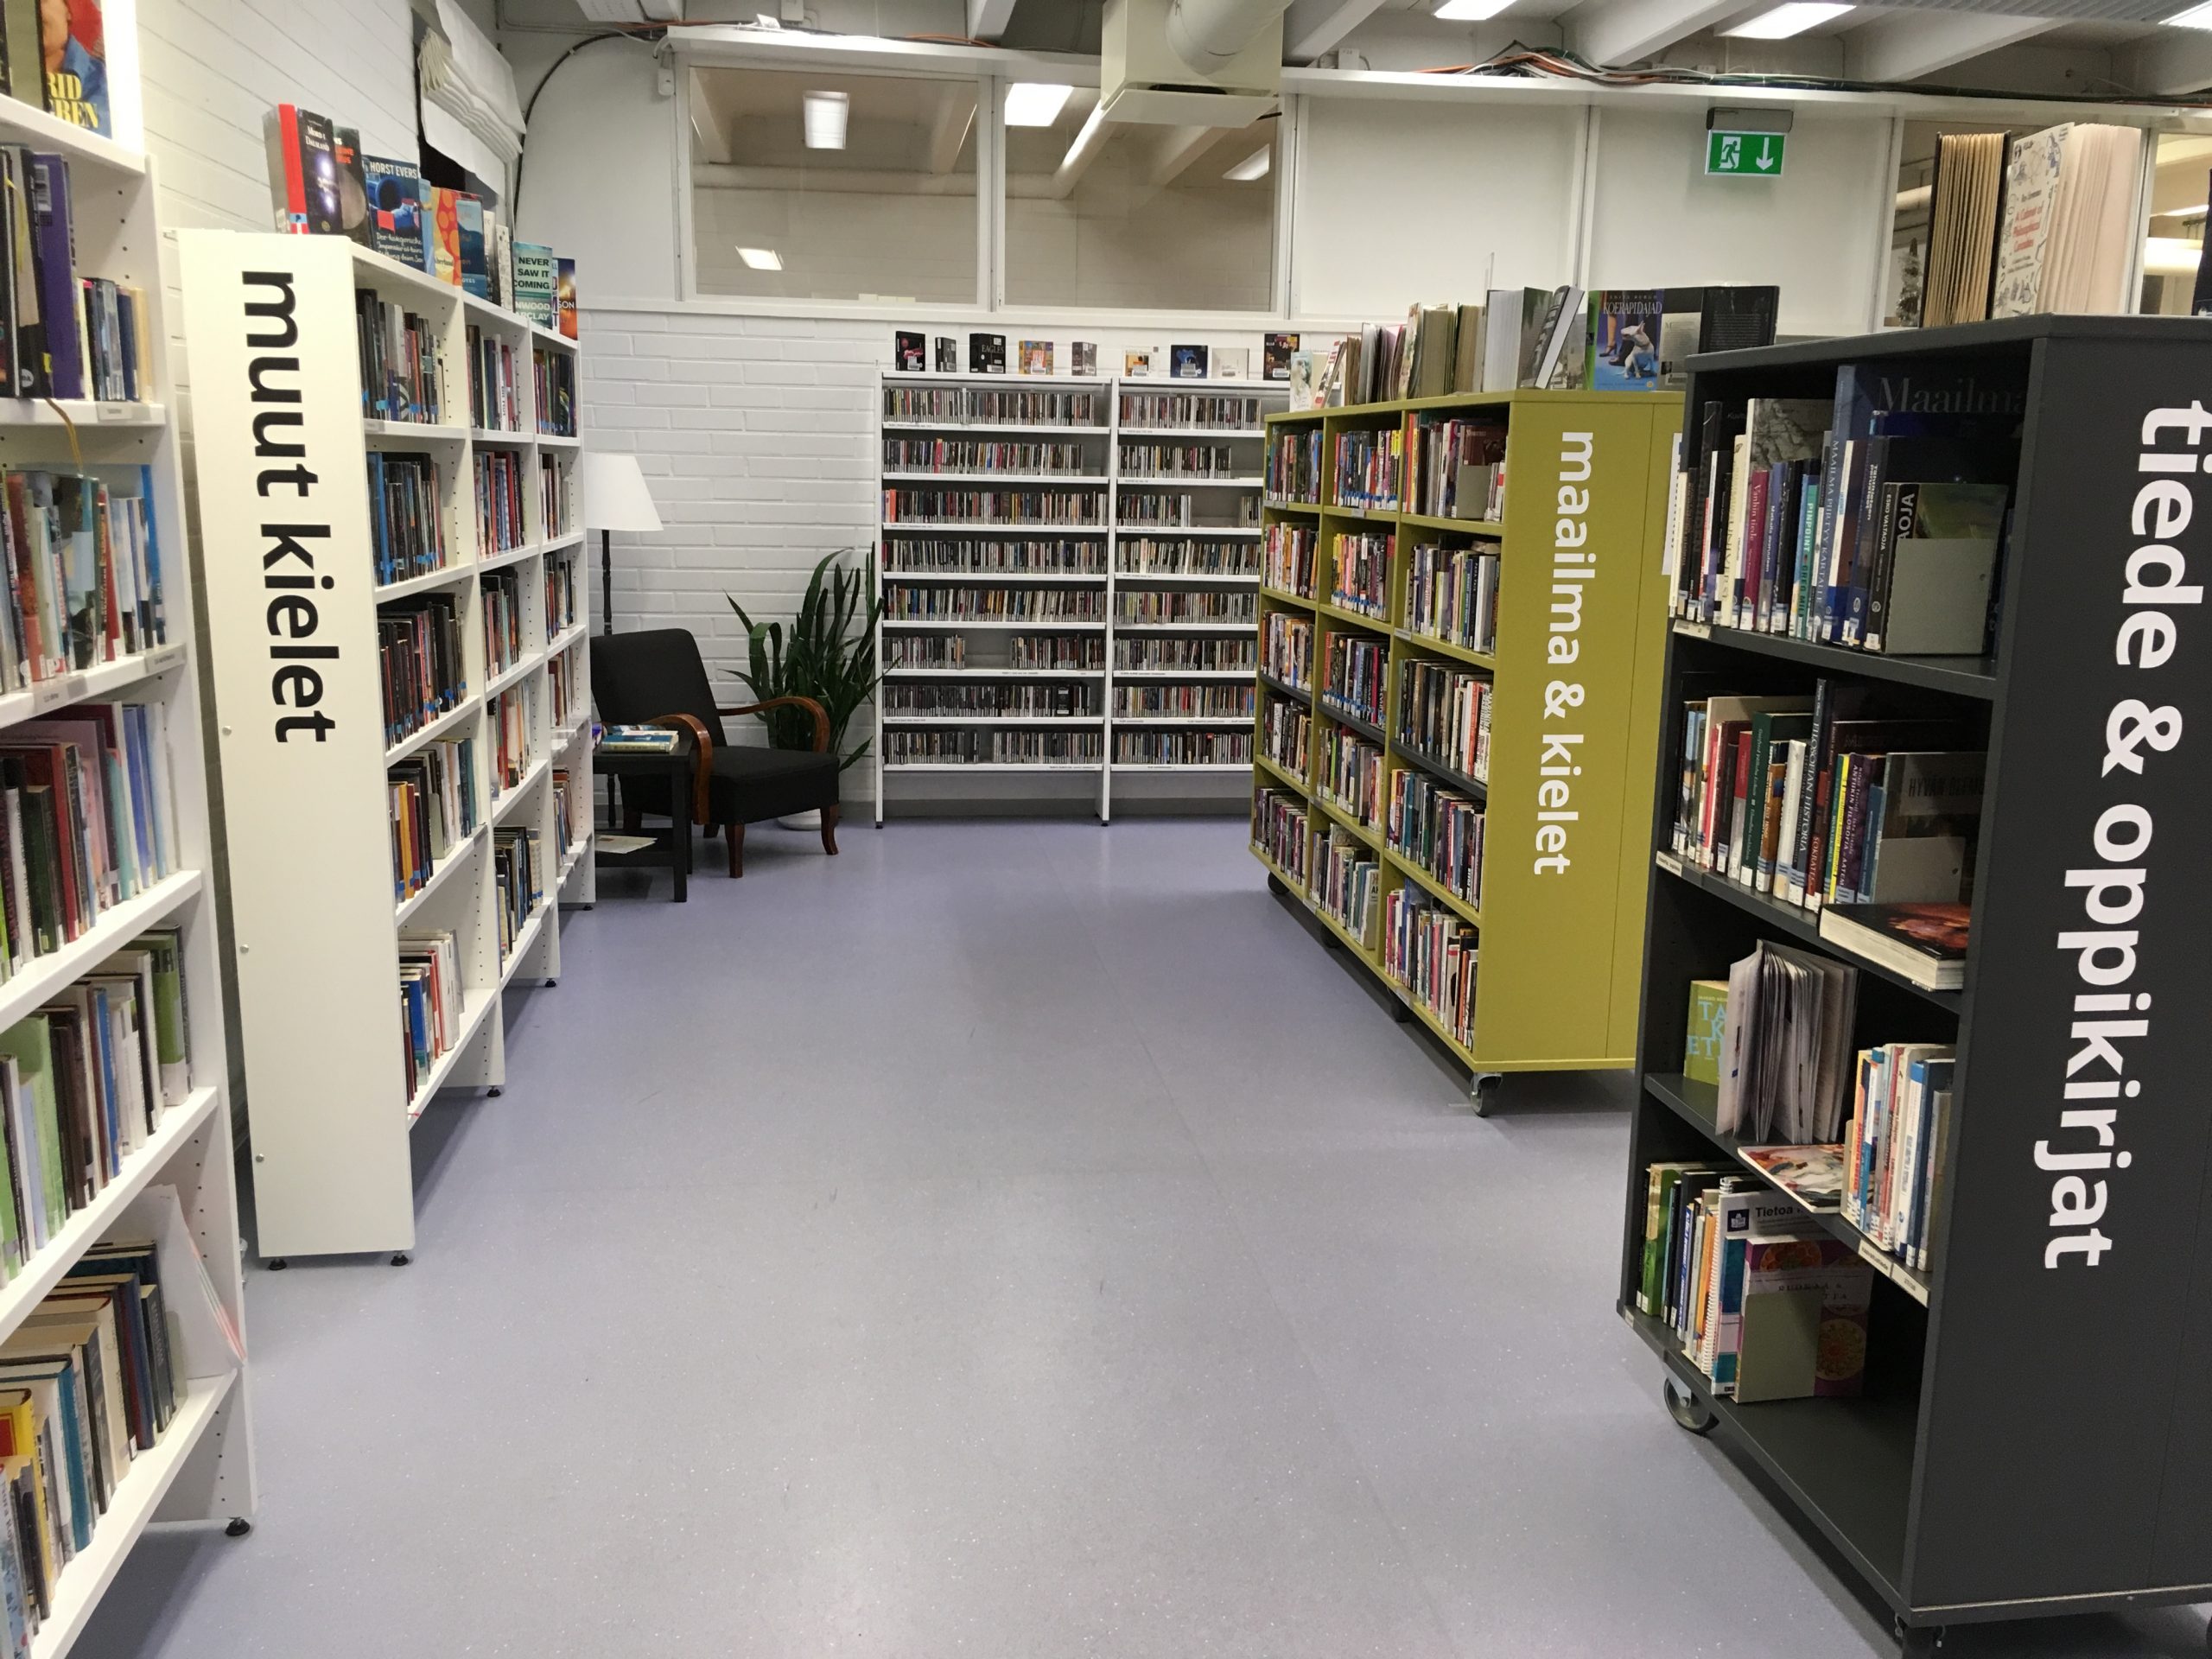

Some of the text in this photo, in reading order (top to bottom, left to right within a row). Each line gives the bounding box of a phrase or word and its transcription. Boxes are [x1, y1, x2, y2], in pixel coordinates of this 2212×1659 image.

[49, 99, 99, 129] REN
[370, 162, 417, 180] HORST EVERS
[518, 257, 550, 267] NEVER
[518, 269, 550, 278] SAW IT
[513, 280, 550, 289] COMING
[1603, 301, 1662, 318] KOERAPIDAJAD
[981, 344, 1005, 353] EAGLES
[241, 270, 340, 743] muut kielet
[1751, 484, 1762, 517] Vanhin
[1749, 519, 1758, 541] tiede
[1803, 503, 1814, 552] PINPOINT
[1816, 441, 1840, 604] MAAILMA PIIRTYY KARTALLE
[1880, 515, 1889, 550] VALTAOJA
[1800, 565, 1808, 593] GREG
[1533, 432, 1595, 875] maailma & kielet
[1805, 722, 1820, 792] FILOSOFIAN
[1849, 765, 1859, 804] ANTIIKIN
[1800, 796, 1812, 852] HISTORIA
[1843, 806, 1853, 850] FILOSOFIA
[2032, 398, 2212, 1271] tiede & oppikirjat
[1756, 1205, 1793, 1217] Tietoa
